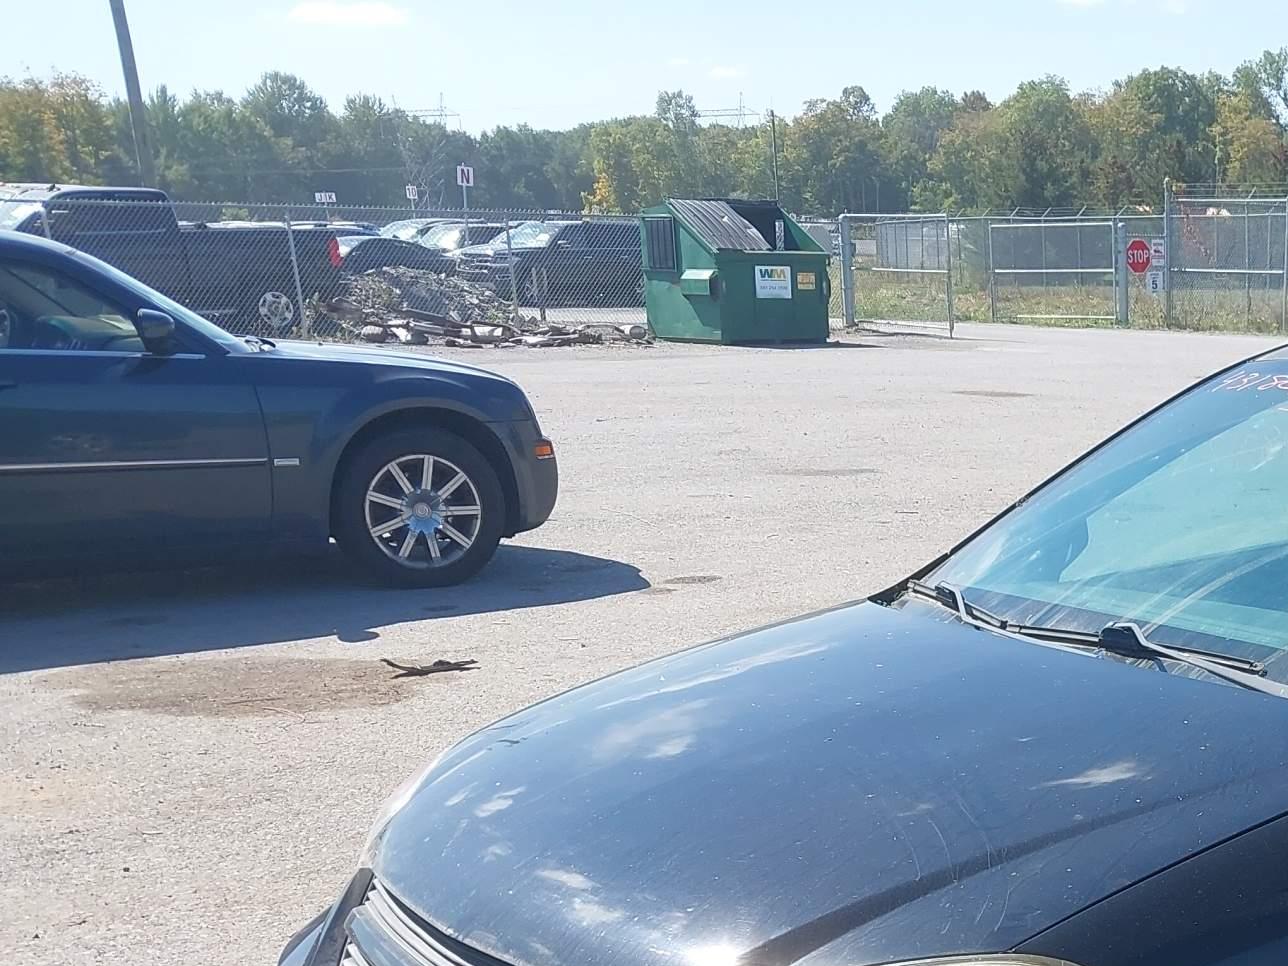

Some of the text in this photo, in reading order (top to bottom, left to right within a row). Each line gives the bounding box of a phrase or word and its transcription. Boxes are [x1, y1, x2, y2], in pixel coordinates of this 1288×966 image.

[460, 168, 470, 185] N
[406, 187, 417, 198] 10
[1127, 250, 1149, 263] STOP
[759, 269, 786, 278] WM
[1152, 280, 1158, 289] 5
